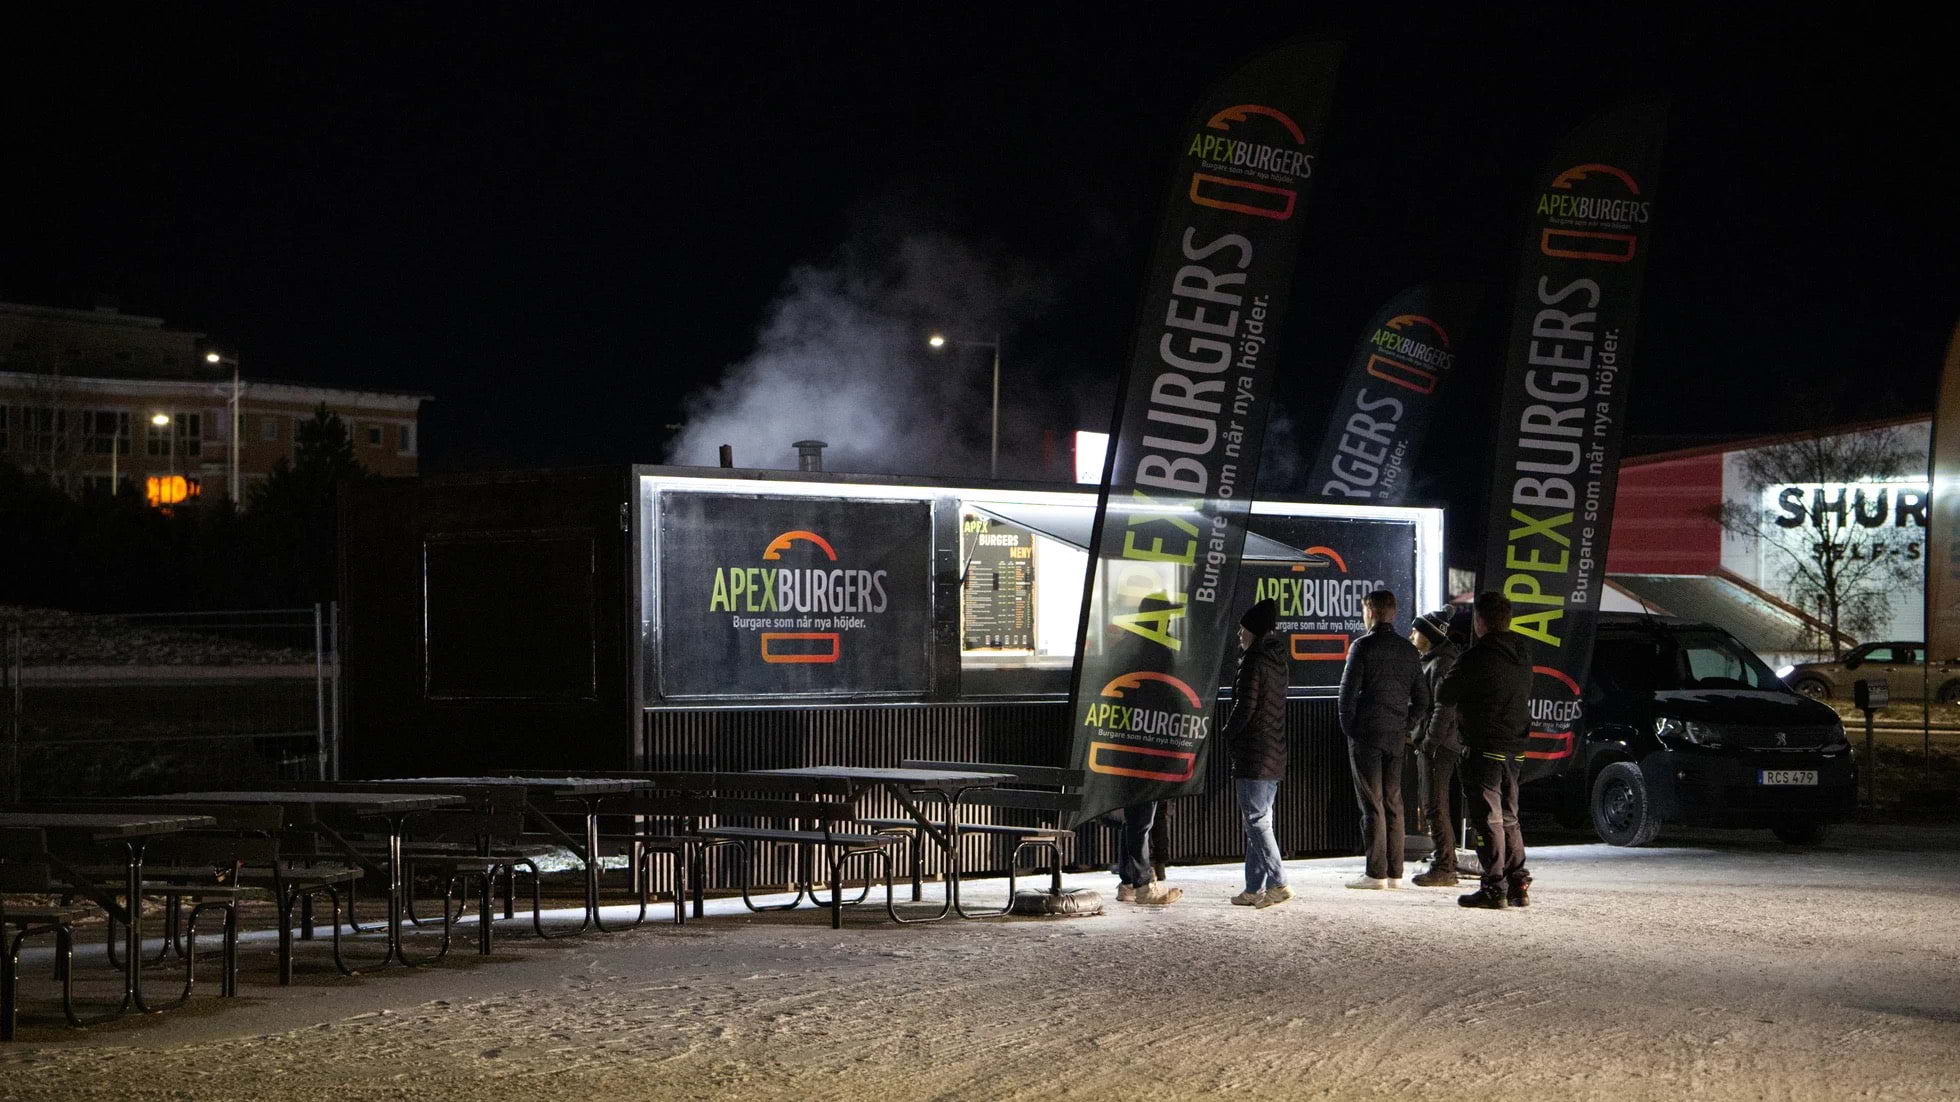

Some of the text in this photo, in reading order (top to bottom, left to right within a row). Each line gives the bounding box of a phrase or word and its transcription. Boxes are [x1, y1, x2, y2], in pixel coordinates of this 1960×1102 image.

[1188, 133, 1315, 178] APEXBURGERS
[1537, 193, 1651, 223] APEXBURGERS
[1237, 294, 1269, 371] höjder.
[1370, 328, 1456, 370] APEXBURGERS
[1232, 376, 1255, 416] nya
[1112, 226, 1253, 651] APEXBURGERS
[1222, 420, 1245, 454] når
[1380, 440, 1409, 488] höjder.
[1503, 275, 1601, 648] APEXBURGERS
[1571, 328, 1619, 603] Burgare som når nya höjder.
[1775, 487, 1928, 528] SHUR
[979, 534, 1019, 547] BURGERS
[1009, 546, 1032, 559] MENY
[1196, 515, 1228, 603] Burgare
[709, 567, 888, 613] APEXBURGERS
[733, 616, 866, 631] Burgare som når nya höjder.
[1275, 621, 1298, 632] urgare
[1300, 621, 1315, 630] som
[1316, 619, 1329, 630] når
[1330, 621, 1343, 632] nya
[1084, 703, 1210, 740] APEXBURGERS
[1098, 728, 1126, 739] Burgare
[1126, 731, 1141, 740] som
[1142, 733, 1155, 742] når
[1156, 737, 1169, 745] nya
[1767, 772, 1814, 783] RCS 479
